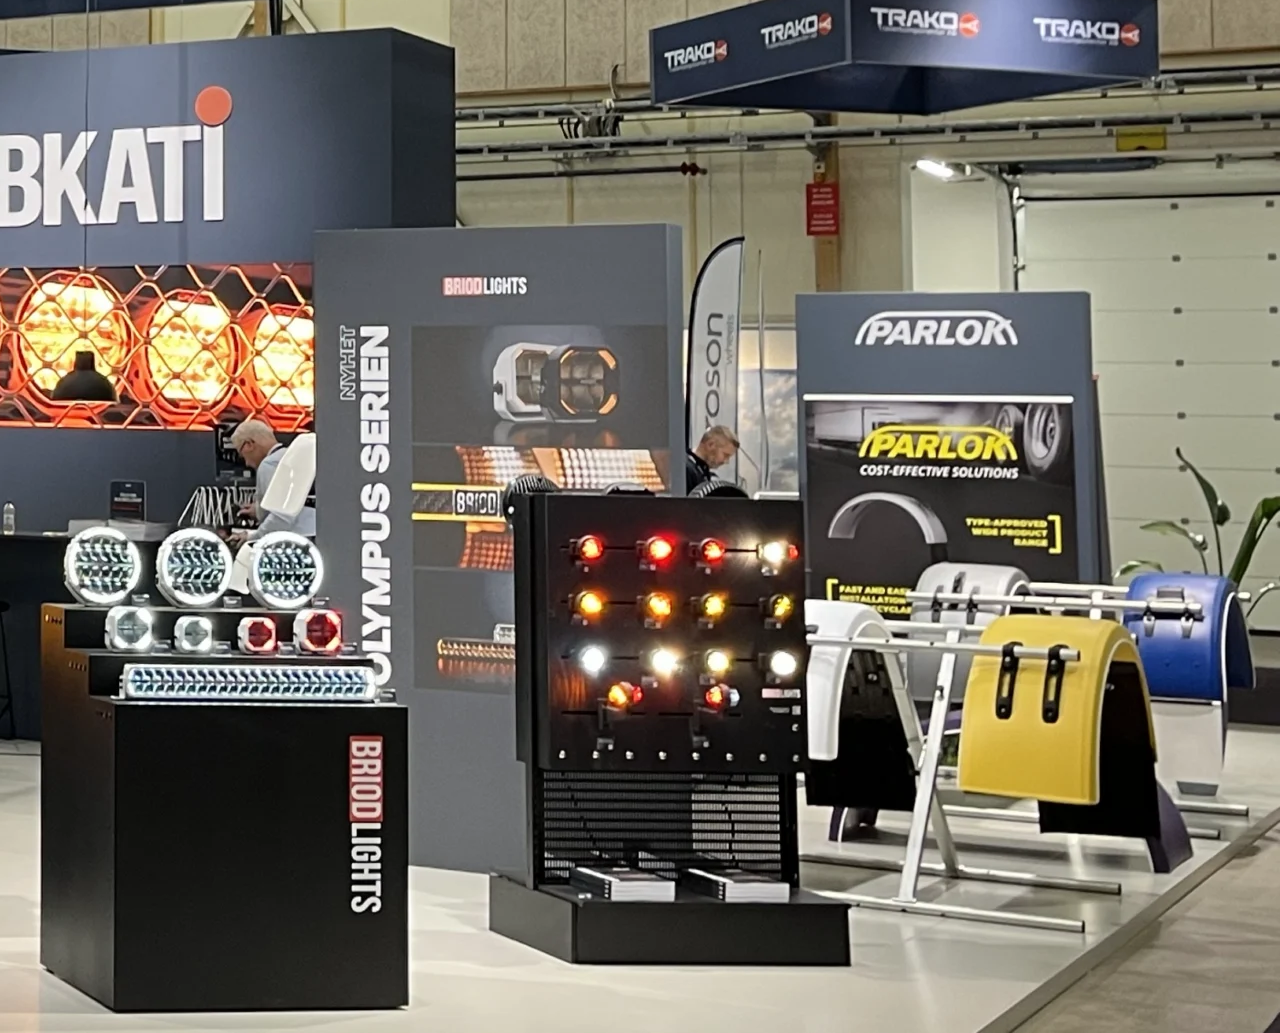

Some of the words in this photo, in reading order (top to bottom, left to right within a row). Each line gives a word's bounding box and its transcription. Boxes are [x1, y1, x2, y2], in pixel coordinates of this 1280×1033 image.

[761, 15, 818, 47] TRAKO
[870, 6, 958, 31] TRAKO
[1033, 17, 1120, 40] TRAKO
[664, 41, 715, 70] TRAKO
[860, 313, 1015, 346] PARLOK
[340, 325, 356, 401] NYHET
[360, 326, 390, 473] SERIEN
[863, 429, 1014, 461] PARLOK
[859, 464, 949, 478] COST-EFFECTIVE
[951, 466, 1019, 480] SOLUTIONS
[965, 517, 1048, 528] TYPE-APPROVED
[971, 527, 999, 536] WIDE
[1000, 529, 1048, 538] PRODUCT
[361, 483, 392, 686] OLYMPUS
[839, 585, 862, 594] FAST
[864, 586, 885, 595] AND
